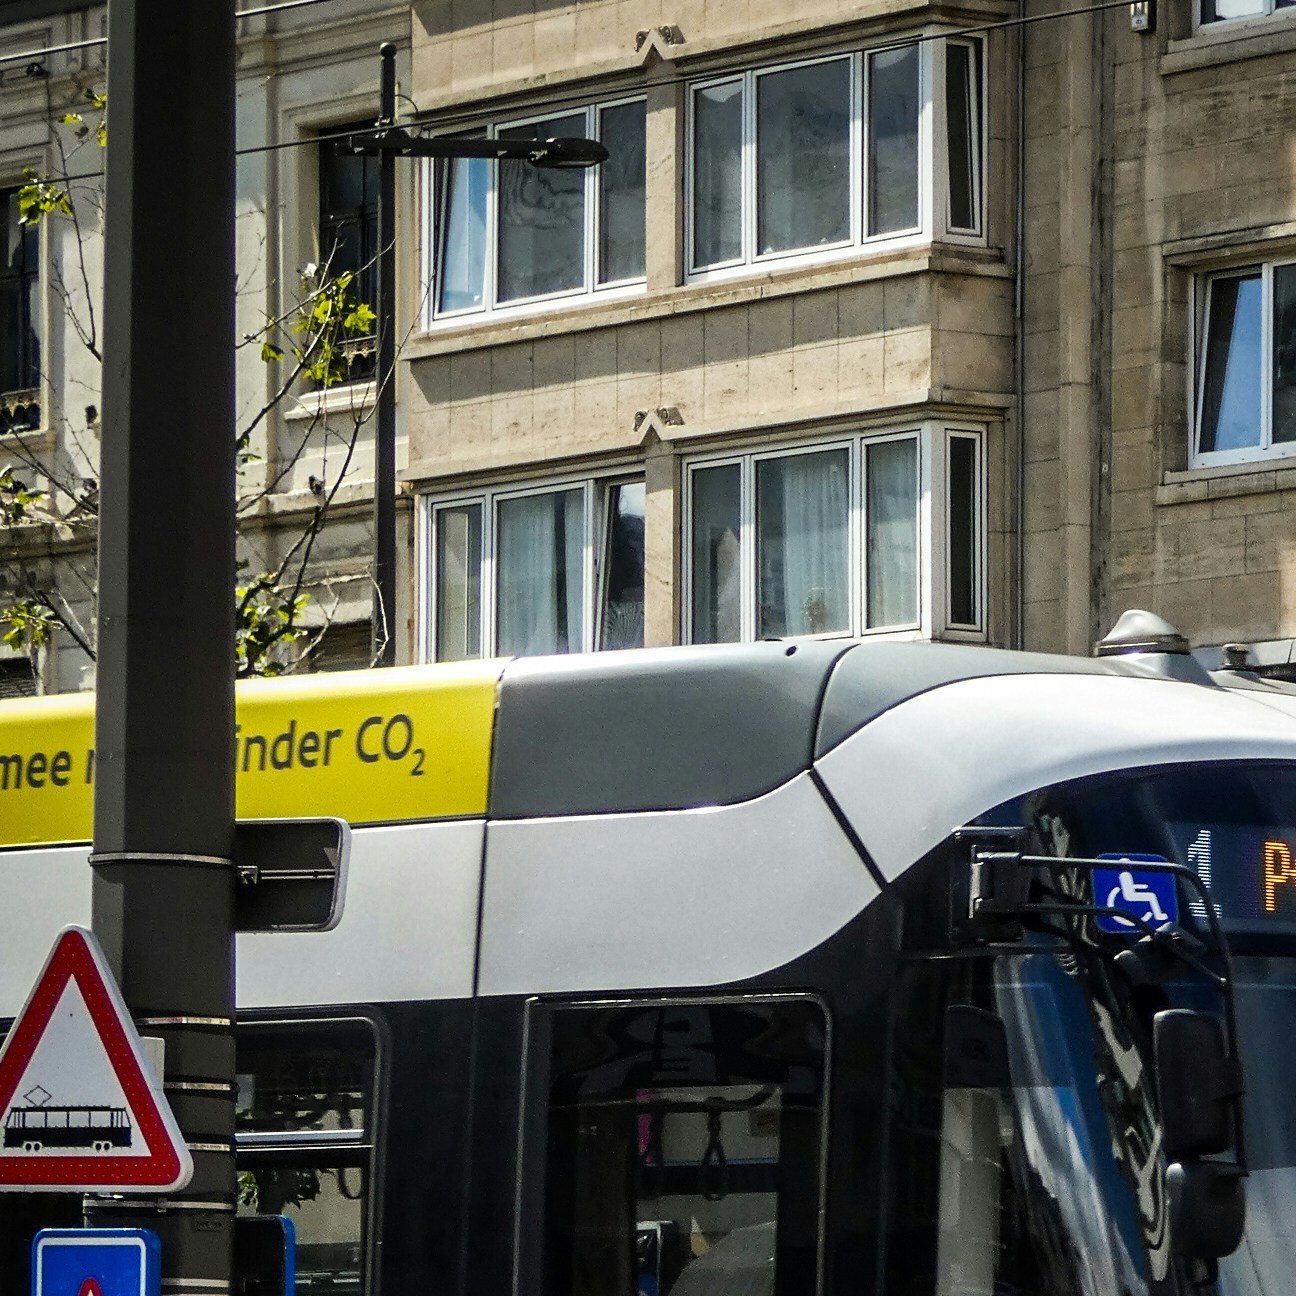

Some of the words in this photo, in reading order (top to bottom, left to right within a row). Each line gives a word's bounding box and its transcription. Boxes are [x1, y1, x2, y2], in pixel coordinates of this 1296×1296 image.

[0, 749, 72, 790] mee
[236, 719, 342, 774] inder
[1187, 829, 1222, 918] 1
